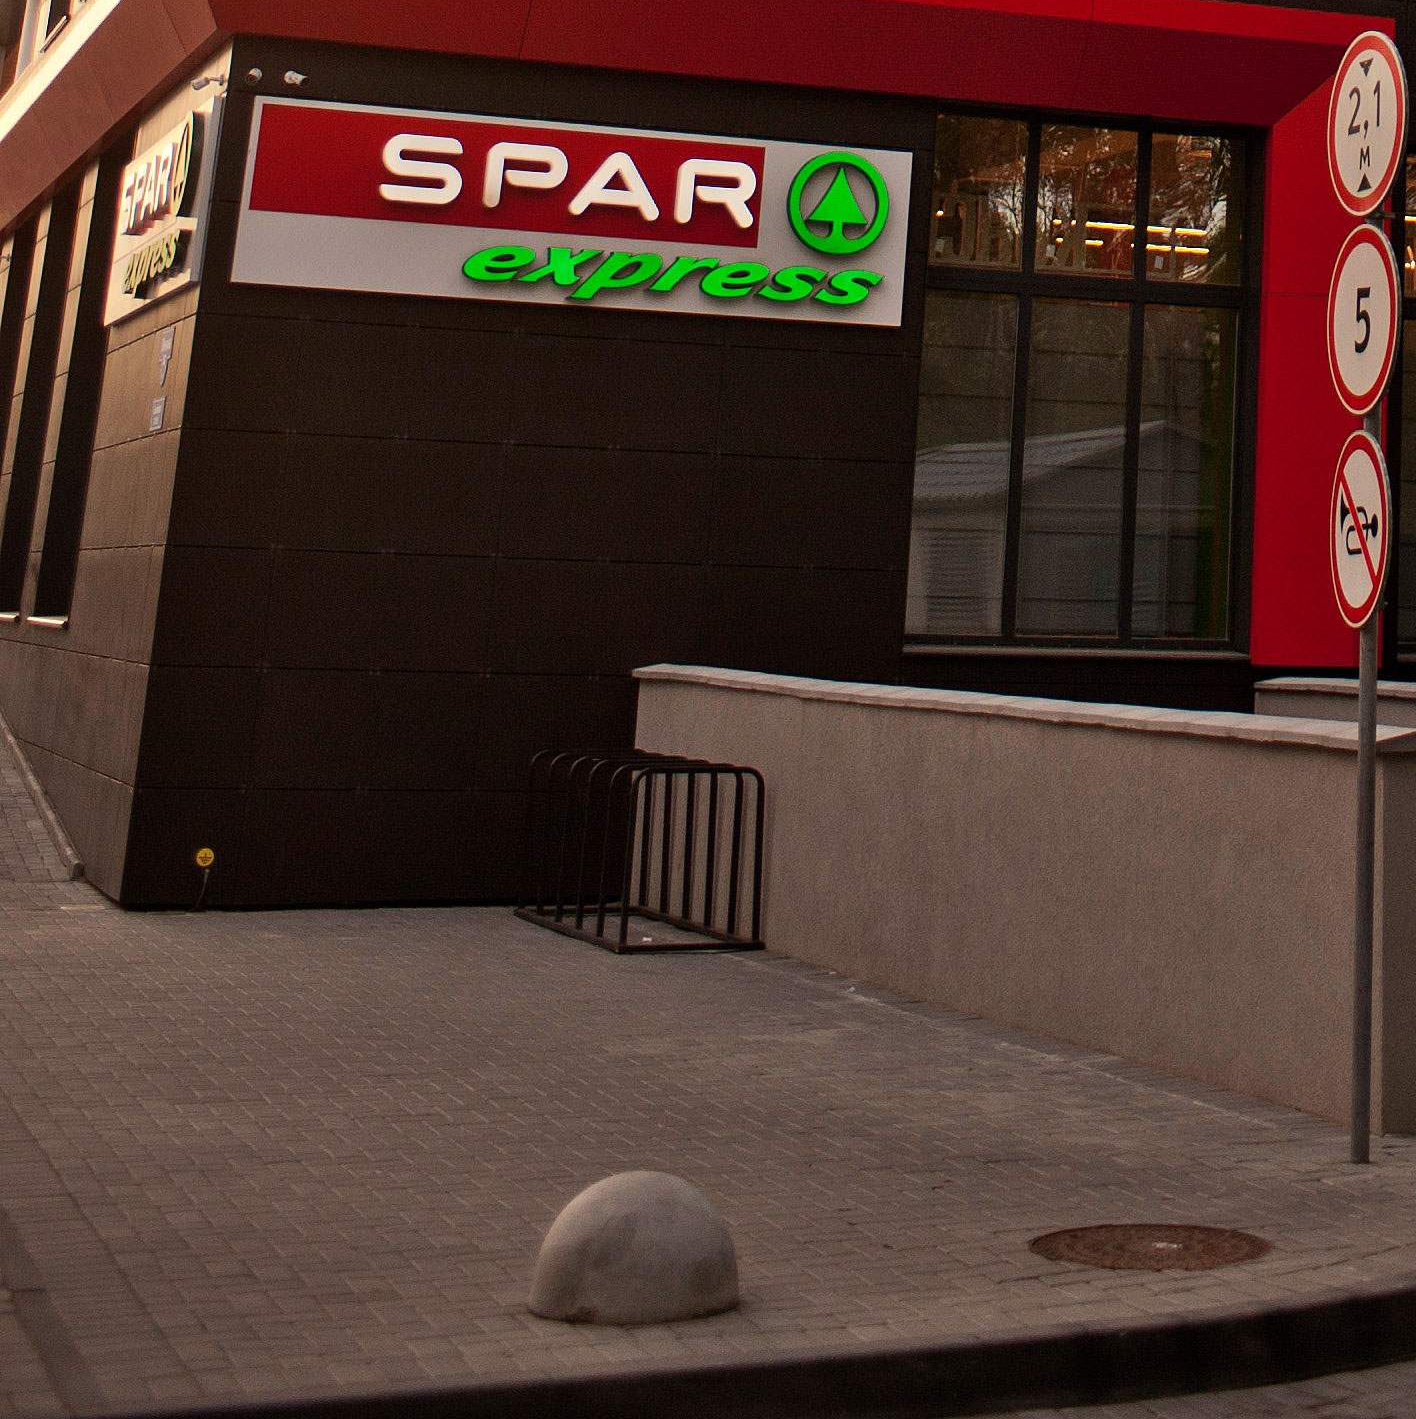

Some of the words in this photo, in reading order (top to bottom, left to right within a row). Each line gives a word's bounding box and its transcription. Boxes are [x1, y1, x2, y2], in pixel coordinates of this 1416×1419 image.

[1348, 79, 1381, 139] 2,1
[120, 141, 174, 236] SPAR
[379, 133, 757, 229] SPAR
[121, 228, 181, 299] express
[462, 244, 884, 306] express
[1354, 286, 1371, 354] 5
